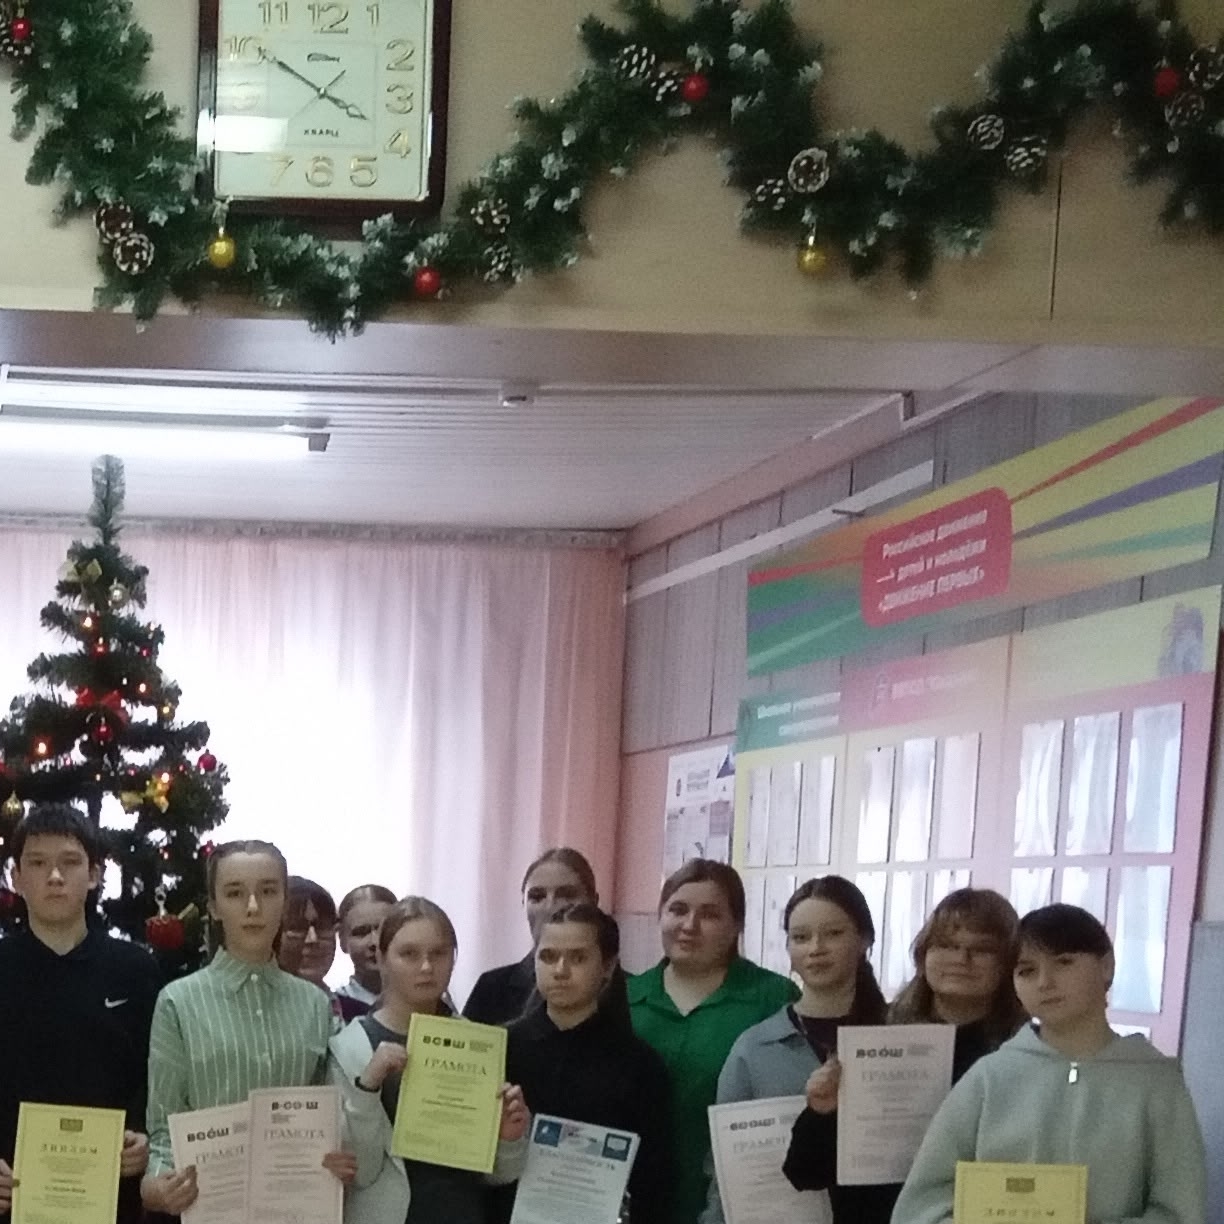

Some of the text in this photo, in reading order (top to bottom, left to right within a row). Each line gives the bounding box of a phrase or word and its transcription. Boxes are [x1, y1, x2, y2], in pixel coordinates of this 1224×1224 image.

[258, 1, 381, 34] 11 12 1
[386, 39, 415, 71] 2
[385, 83, 414, 115] 3
[384, 128, 412, 159] 4
[269, 155, 378, 188] 7 6 5
[264, 1128, 325, 1140] ГРАМОТА
